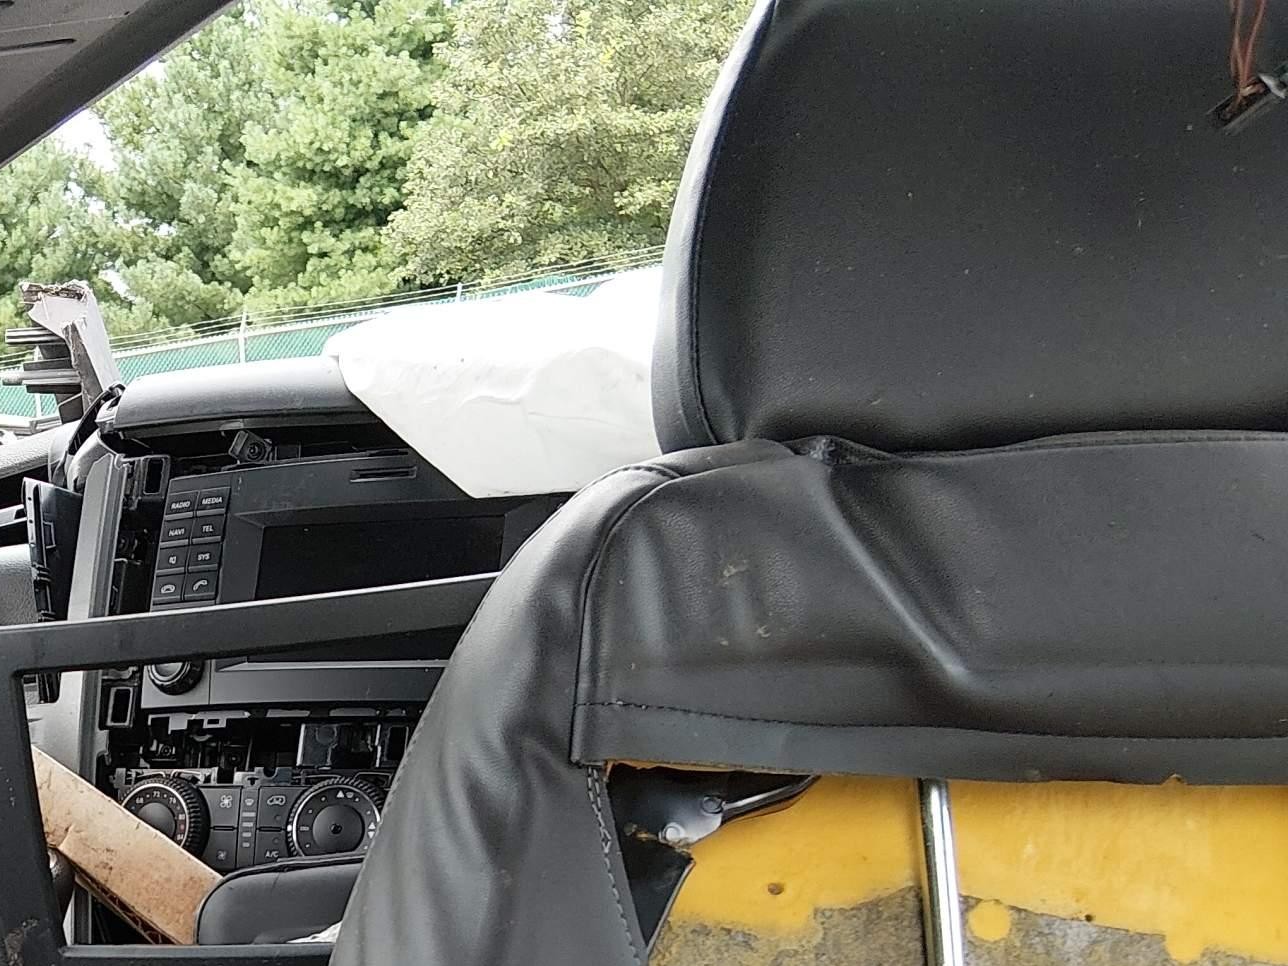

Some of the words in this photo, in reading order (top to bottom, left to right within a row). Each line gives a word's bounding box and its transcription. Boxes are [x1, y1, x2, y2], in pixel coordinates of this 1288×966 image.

[171, 500, 191, 509] RADIO
[201, 496, 223, 505] MEDIA
[168, 528, 185, 537] NAVI
[202, 525, 214, 533] TEL
[197, 552, 210, 561] SYS
[265, 850, 279, 858] A/C
